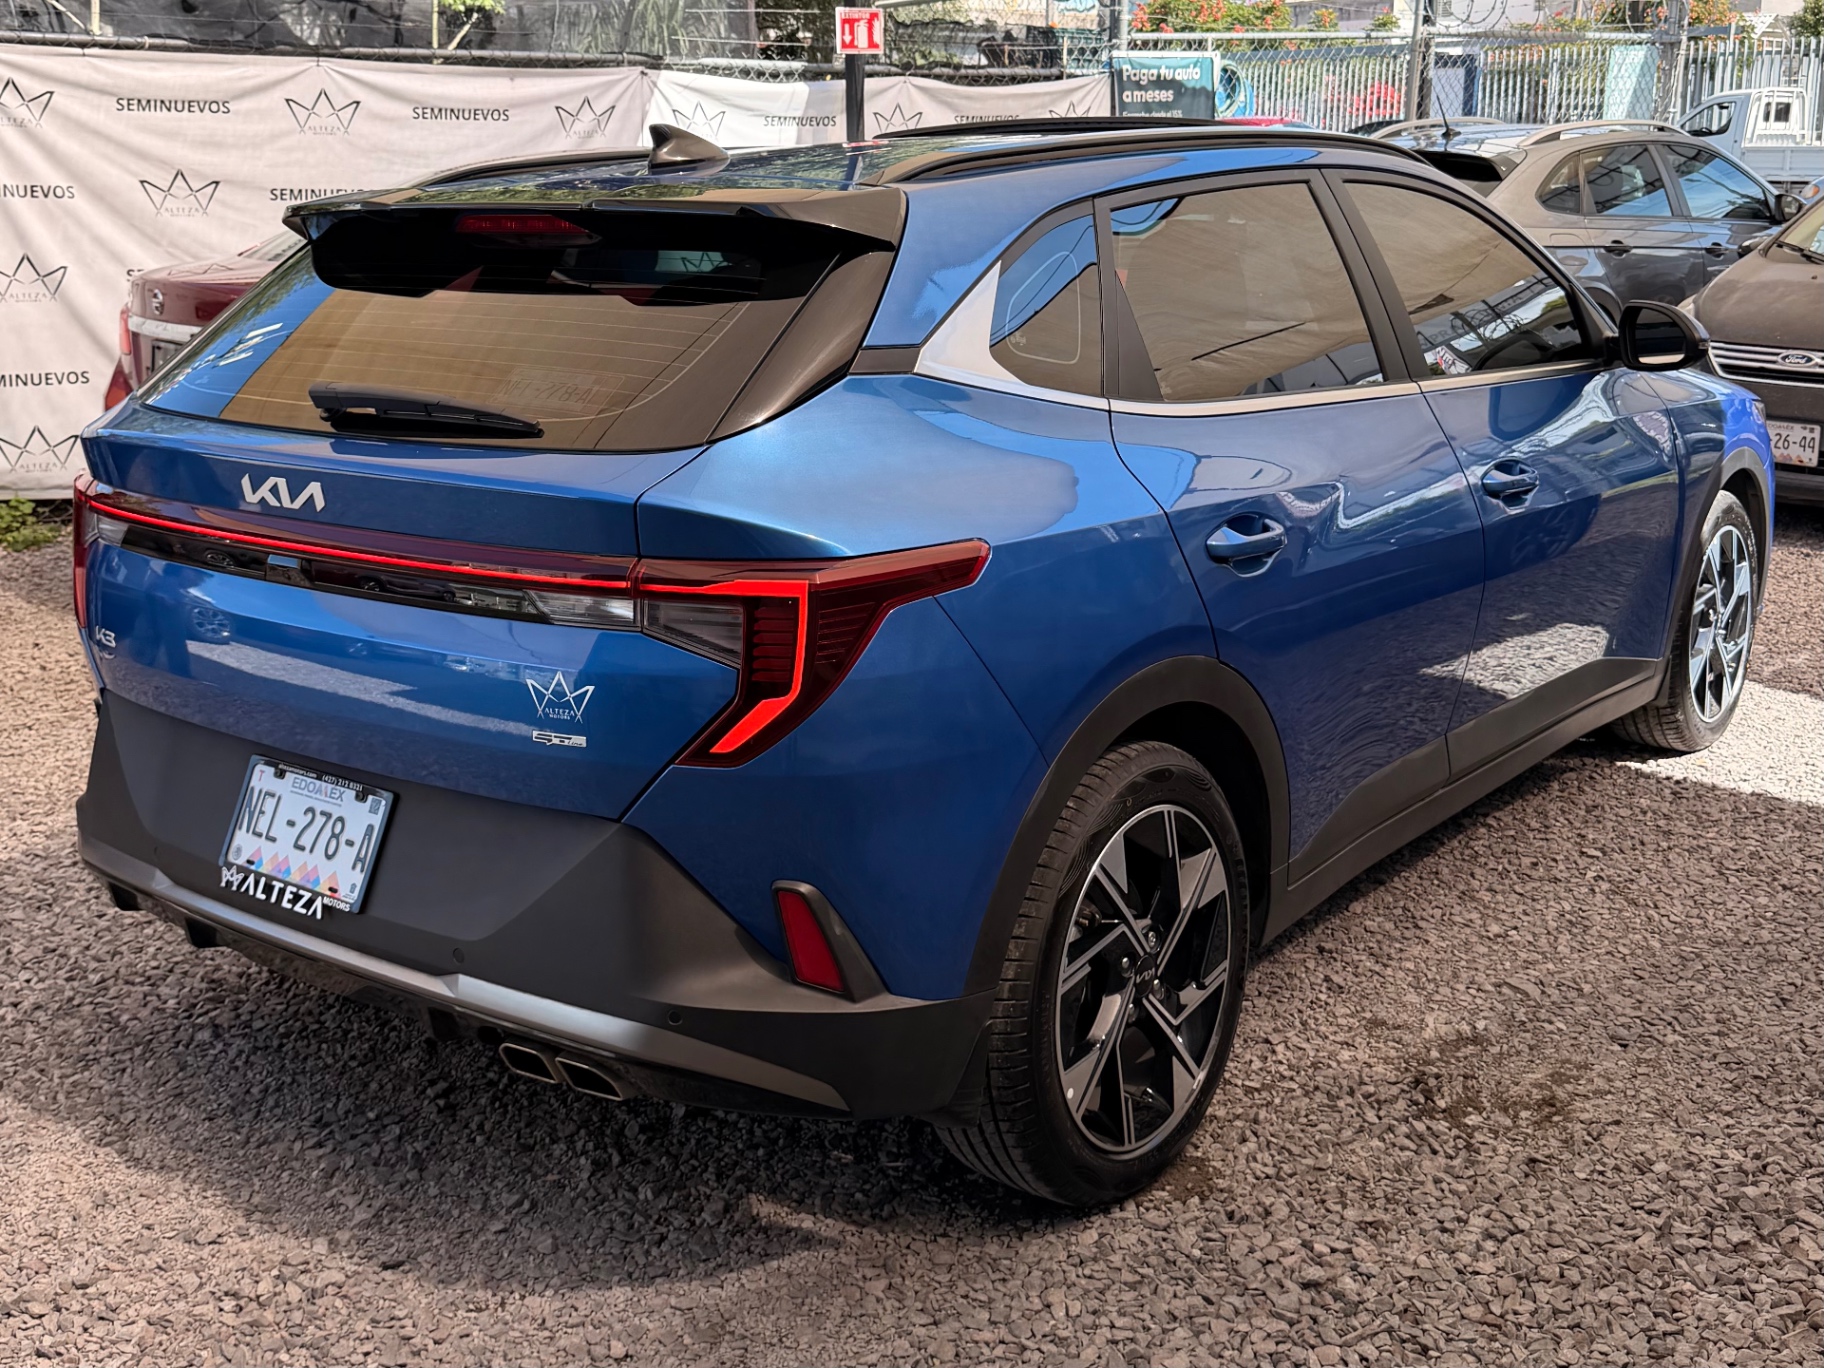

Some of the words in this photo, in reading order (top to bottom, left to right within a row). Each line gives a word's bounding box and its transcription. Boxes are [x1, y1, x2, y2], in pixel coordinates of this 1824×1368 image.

[1122, 64, 1158, 85] Paga
[1160, 65, 1174, 80] tu
[1175, 64, 1201, 80] auto
[1122, 90, 1132, 103] a
[1133, 90, 1174, 103] meses
[116, 97, 231, 115] SEMINUEVOS
[412, 106, 510, 122] SEMINUEVOS
[763, 115, 837, 127] SEMINUEVOS
[1784, 353, 1808, 364] Ford
[240, 472, 326, 513] KIA
[95, 625, 116, 648] K3
[545, 707, 575, 717] ALTEZA
[258, 769, 266, 783] T
[238, 785, 376, 874] NEL-278-A
[239, 872, 324, 920] ALTEZA
[322, 895, 351, 912] MOTORS
